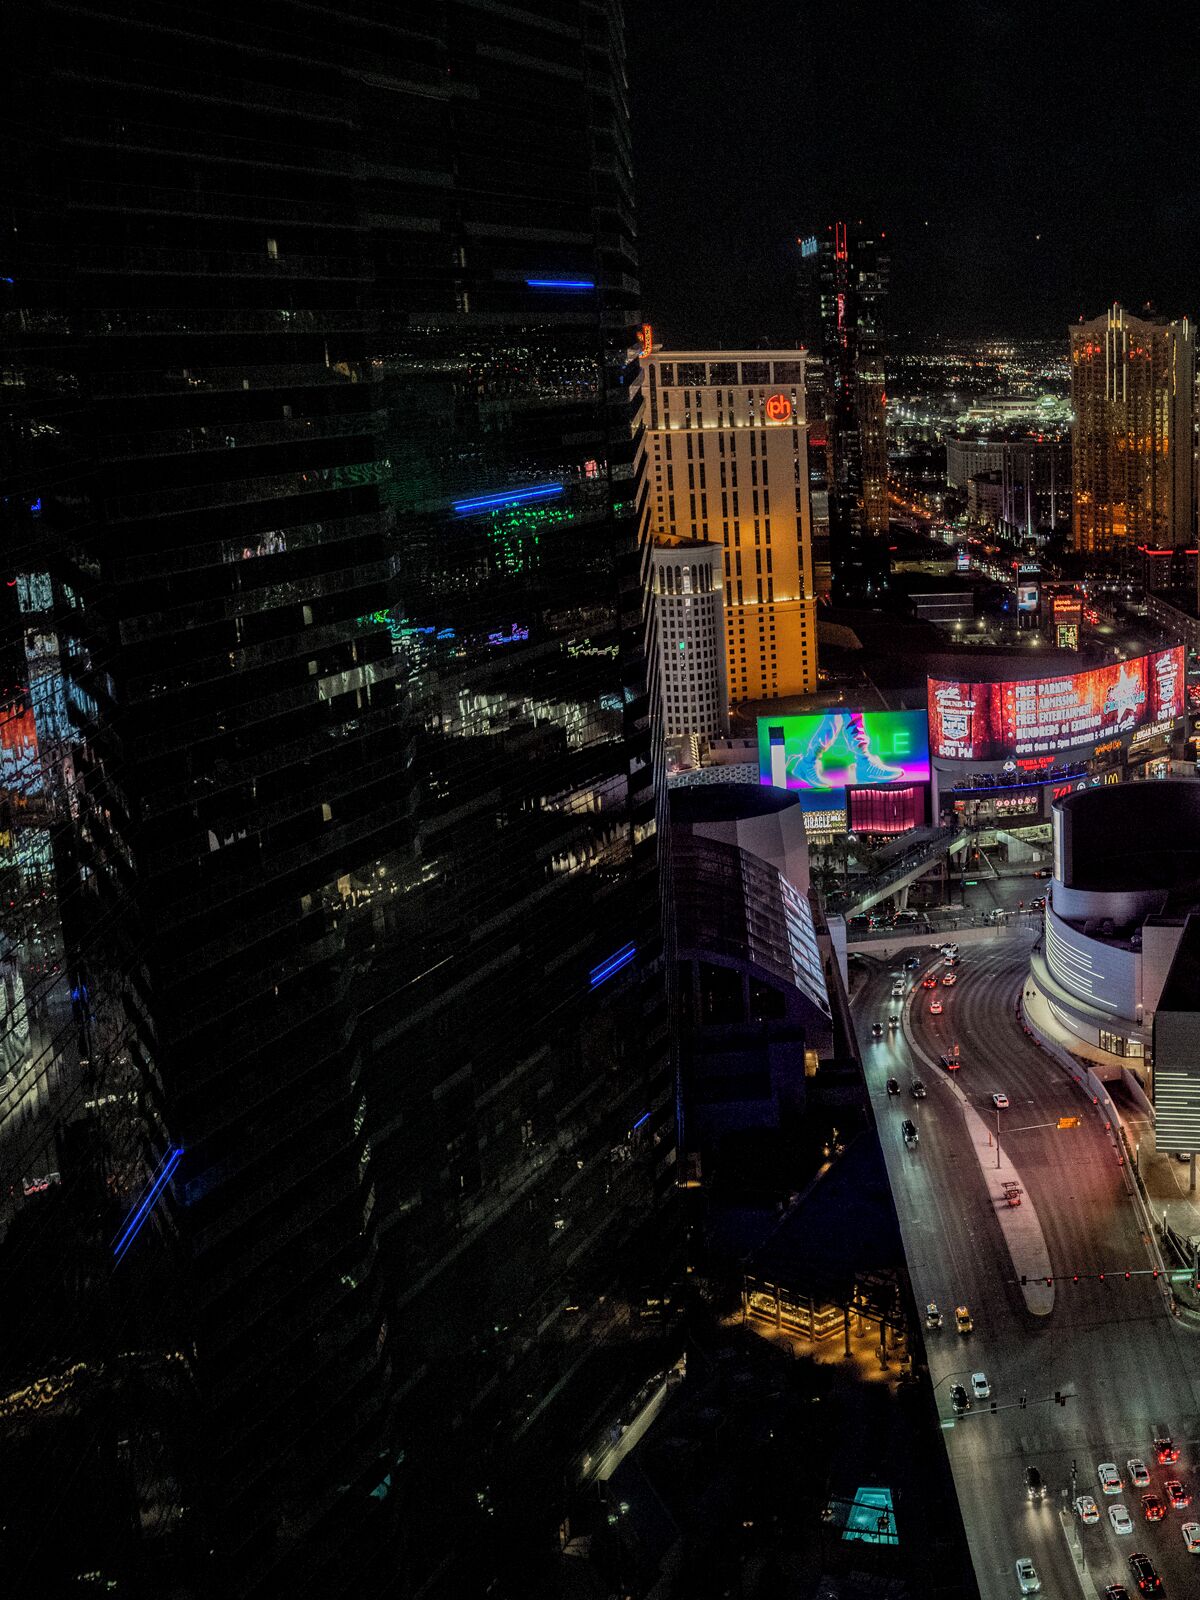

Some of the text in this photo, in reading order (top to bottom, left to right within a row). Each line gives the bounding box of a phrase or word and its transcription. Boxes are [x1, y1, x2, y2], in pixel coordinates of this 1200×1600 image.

[769, 394, 791, 418] ph
[1015, 680, 1073, 698] FREE PARKING
[1015, 693, 1078, 712] FREE ADMISSION
[1015, 703, 1092, 726] FREE ENTERTAINMENT
[1016, 723, 1060, 740] HUNDREDS
